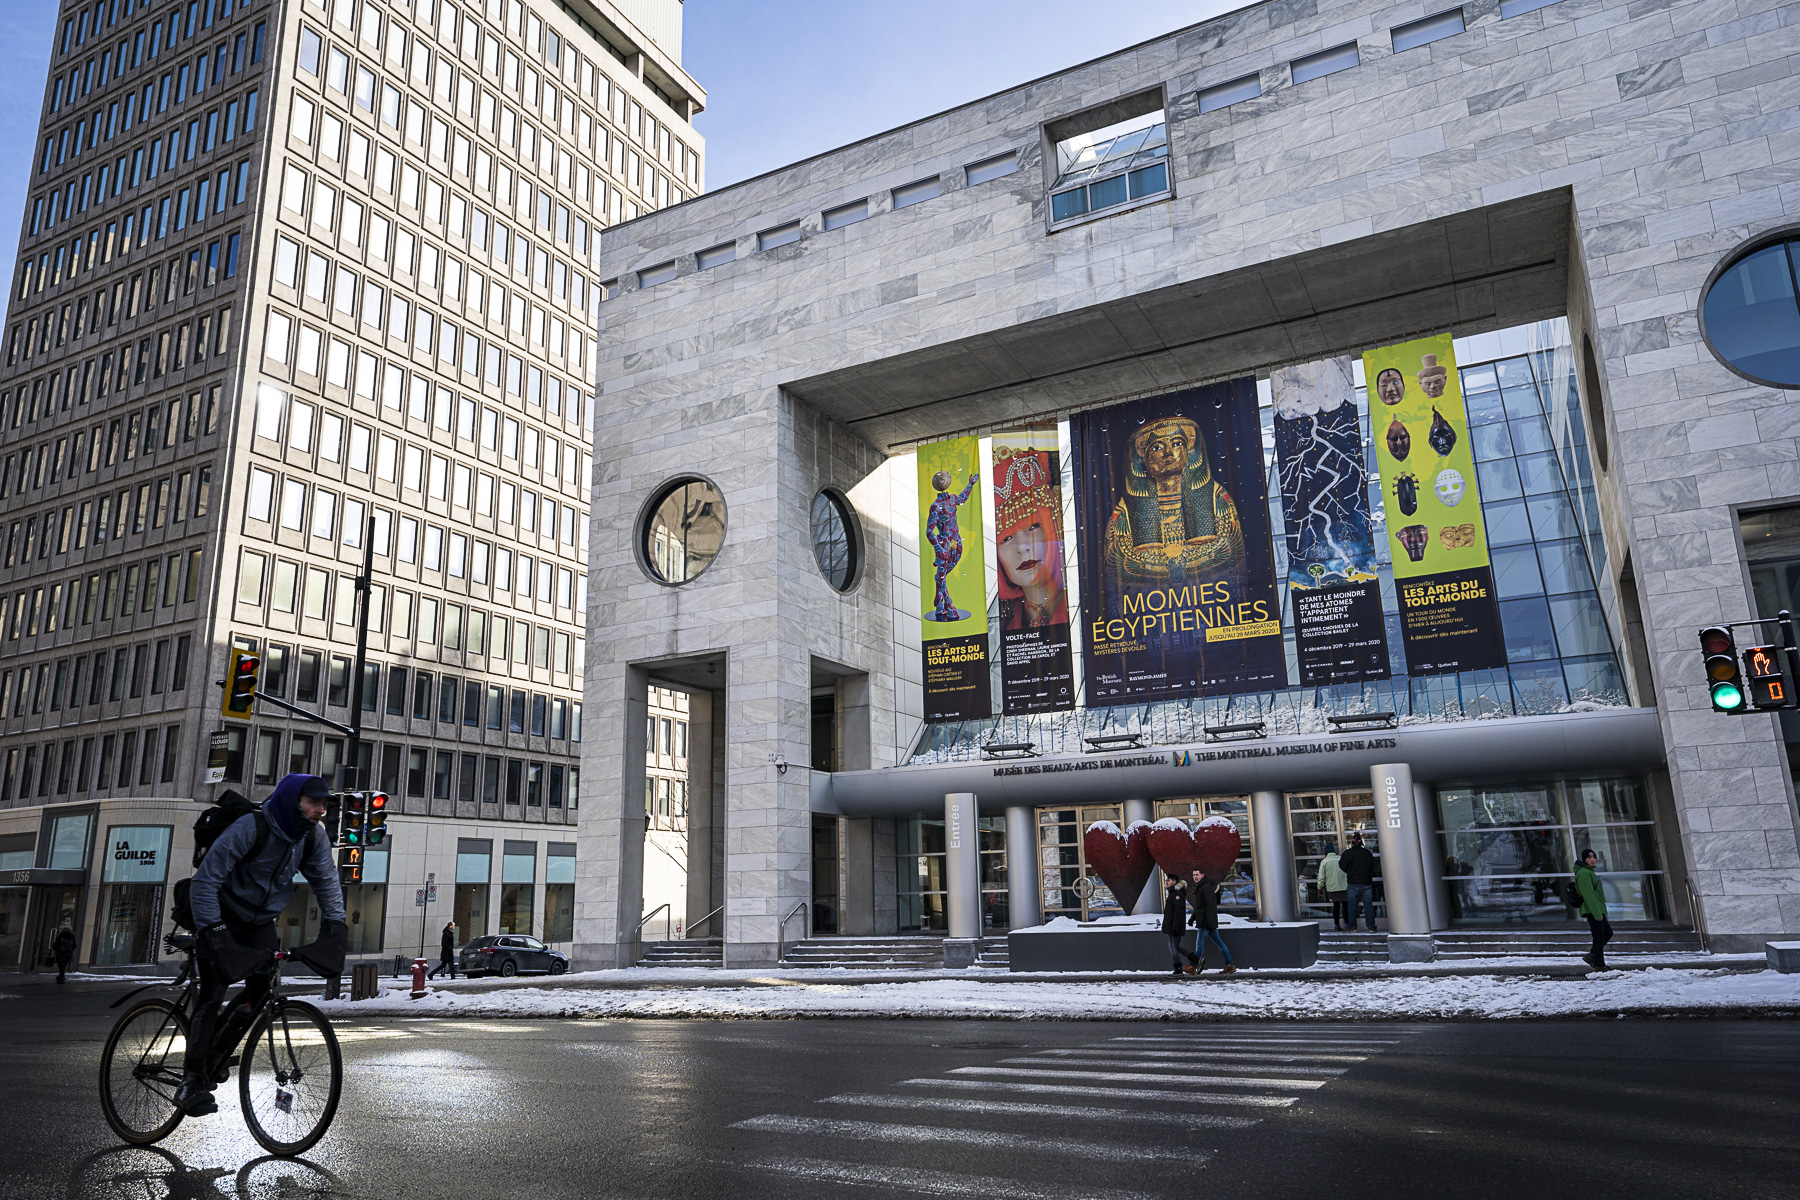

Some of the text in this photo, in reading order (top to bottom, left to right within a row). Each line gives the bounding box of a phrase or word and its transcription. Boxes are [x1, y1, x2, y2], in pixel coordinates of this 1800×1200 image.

[1403, 581, 1434, 589] RENCONTREZ
[1404, 580, 1478, 598] LES ARTS DU
[1123, 581, 1230, 614] MOMIES
[1334, 590, 1365, 598] MOINDRE
[1405, 589, 1486, 607] TOUT-MONDE
[1326, 599, 1353, 607] ATOMES
[1300, 606, 1348, 617] T'APPARTIENT
[1093, 600, 1269, 642] ÉGYPTIENNES
[1232, 622, 1277, 631] PROLONGATION
[1006, 632, 1039, 641] VOLTE-FACE
[944, 647, 966, 656] ARTS
[928, 652, 984, 665] TOUT-MONDE
[1195, 738, 1396, 762] THE MONTREAL MUSEUM OF FINE ARTS
[993, 754, 1167, 776] MUSÉE DES BEAUX-ARTS DE MONTRÉAL
[1383, 777, 1401, 828] Entrée
[950, 805, 960, 848] Entrée
[116, 841, 129, 850] LA
[115, 850, 156, 860] GUILDE
[13, 870, 29, 882] 1356
